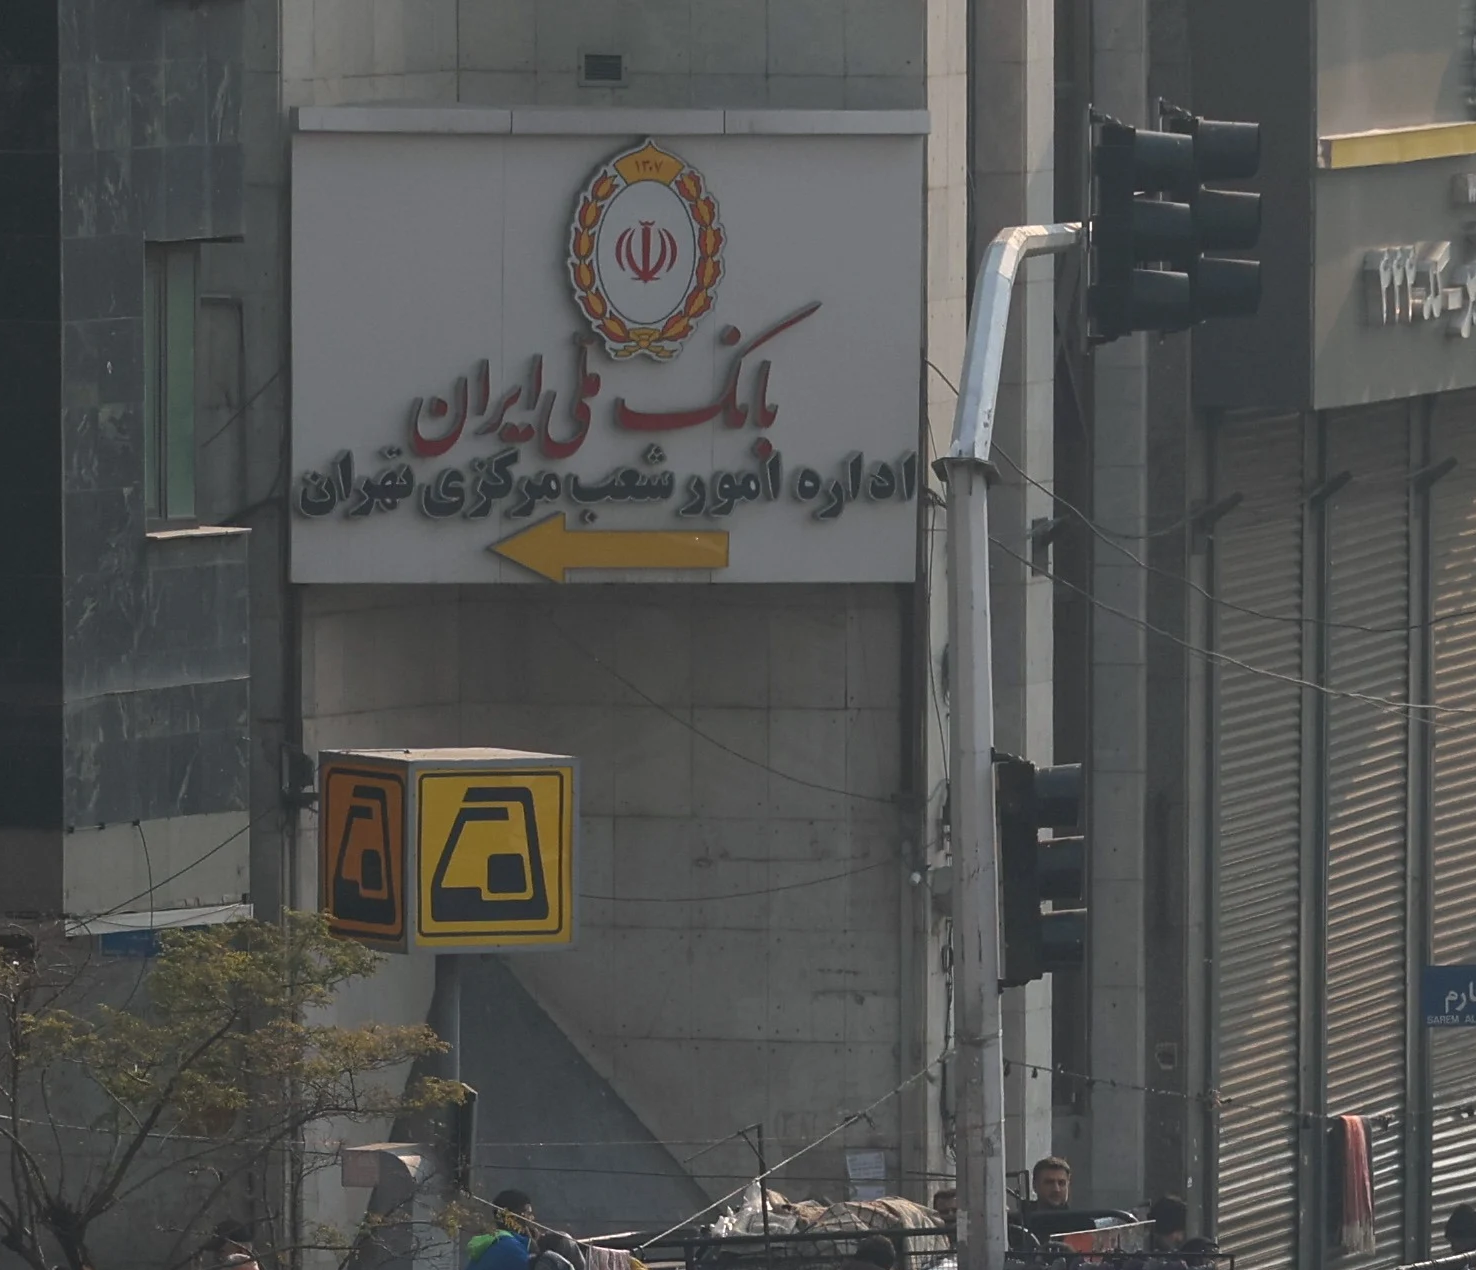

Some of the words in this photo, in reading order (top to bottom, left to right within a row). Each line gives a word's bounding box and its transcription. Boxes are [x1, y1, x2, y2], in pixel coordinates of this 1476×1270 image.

[410, 356, 543, 456] ایران
[540, 333, 601, 457] ملی
[613, 302, 823, 455] بانک
[299, 447, 414, 518] تهران
[421, 450, 563, 519] مرکزی
[571, 445, 674, 522] شعب
[677, 452, 781, 516] امور
[797, 450, 917, 518] اداره
[1427, 1014, 1459, 1024] SAREM
